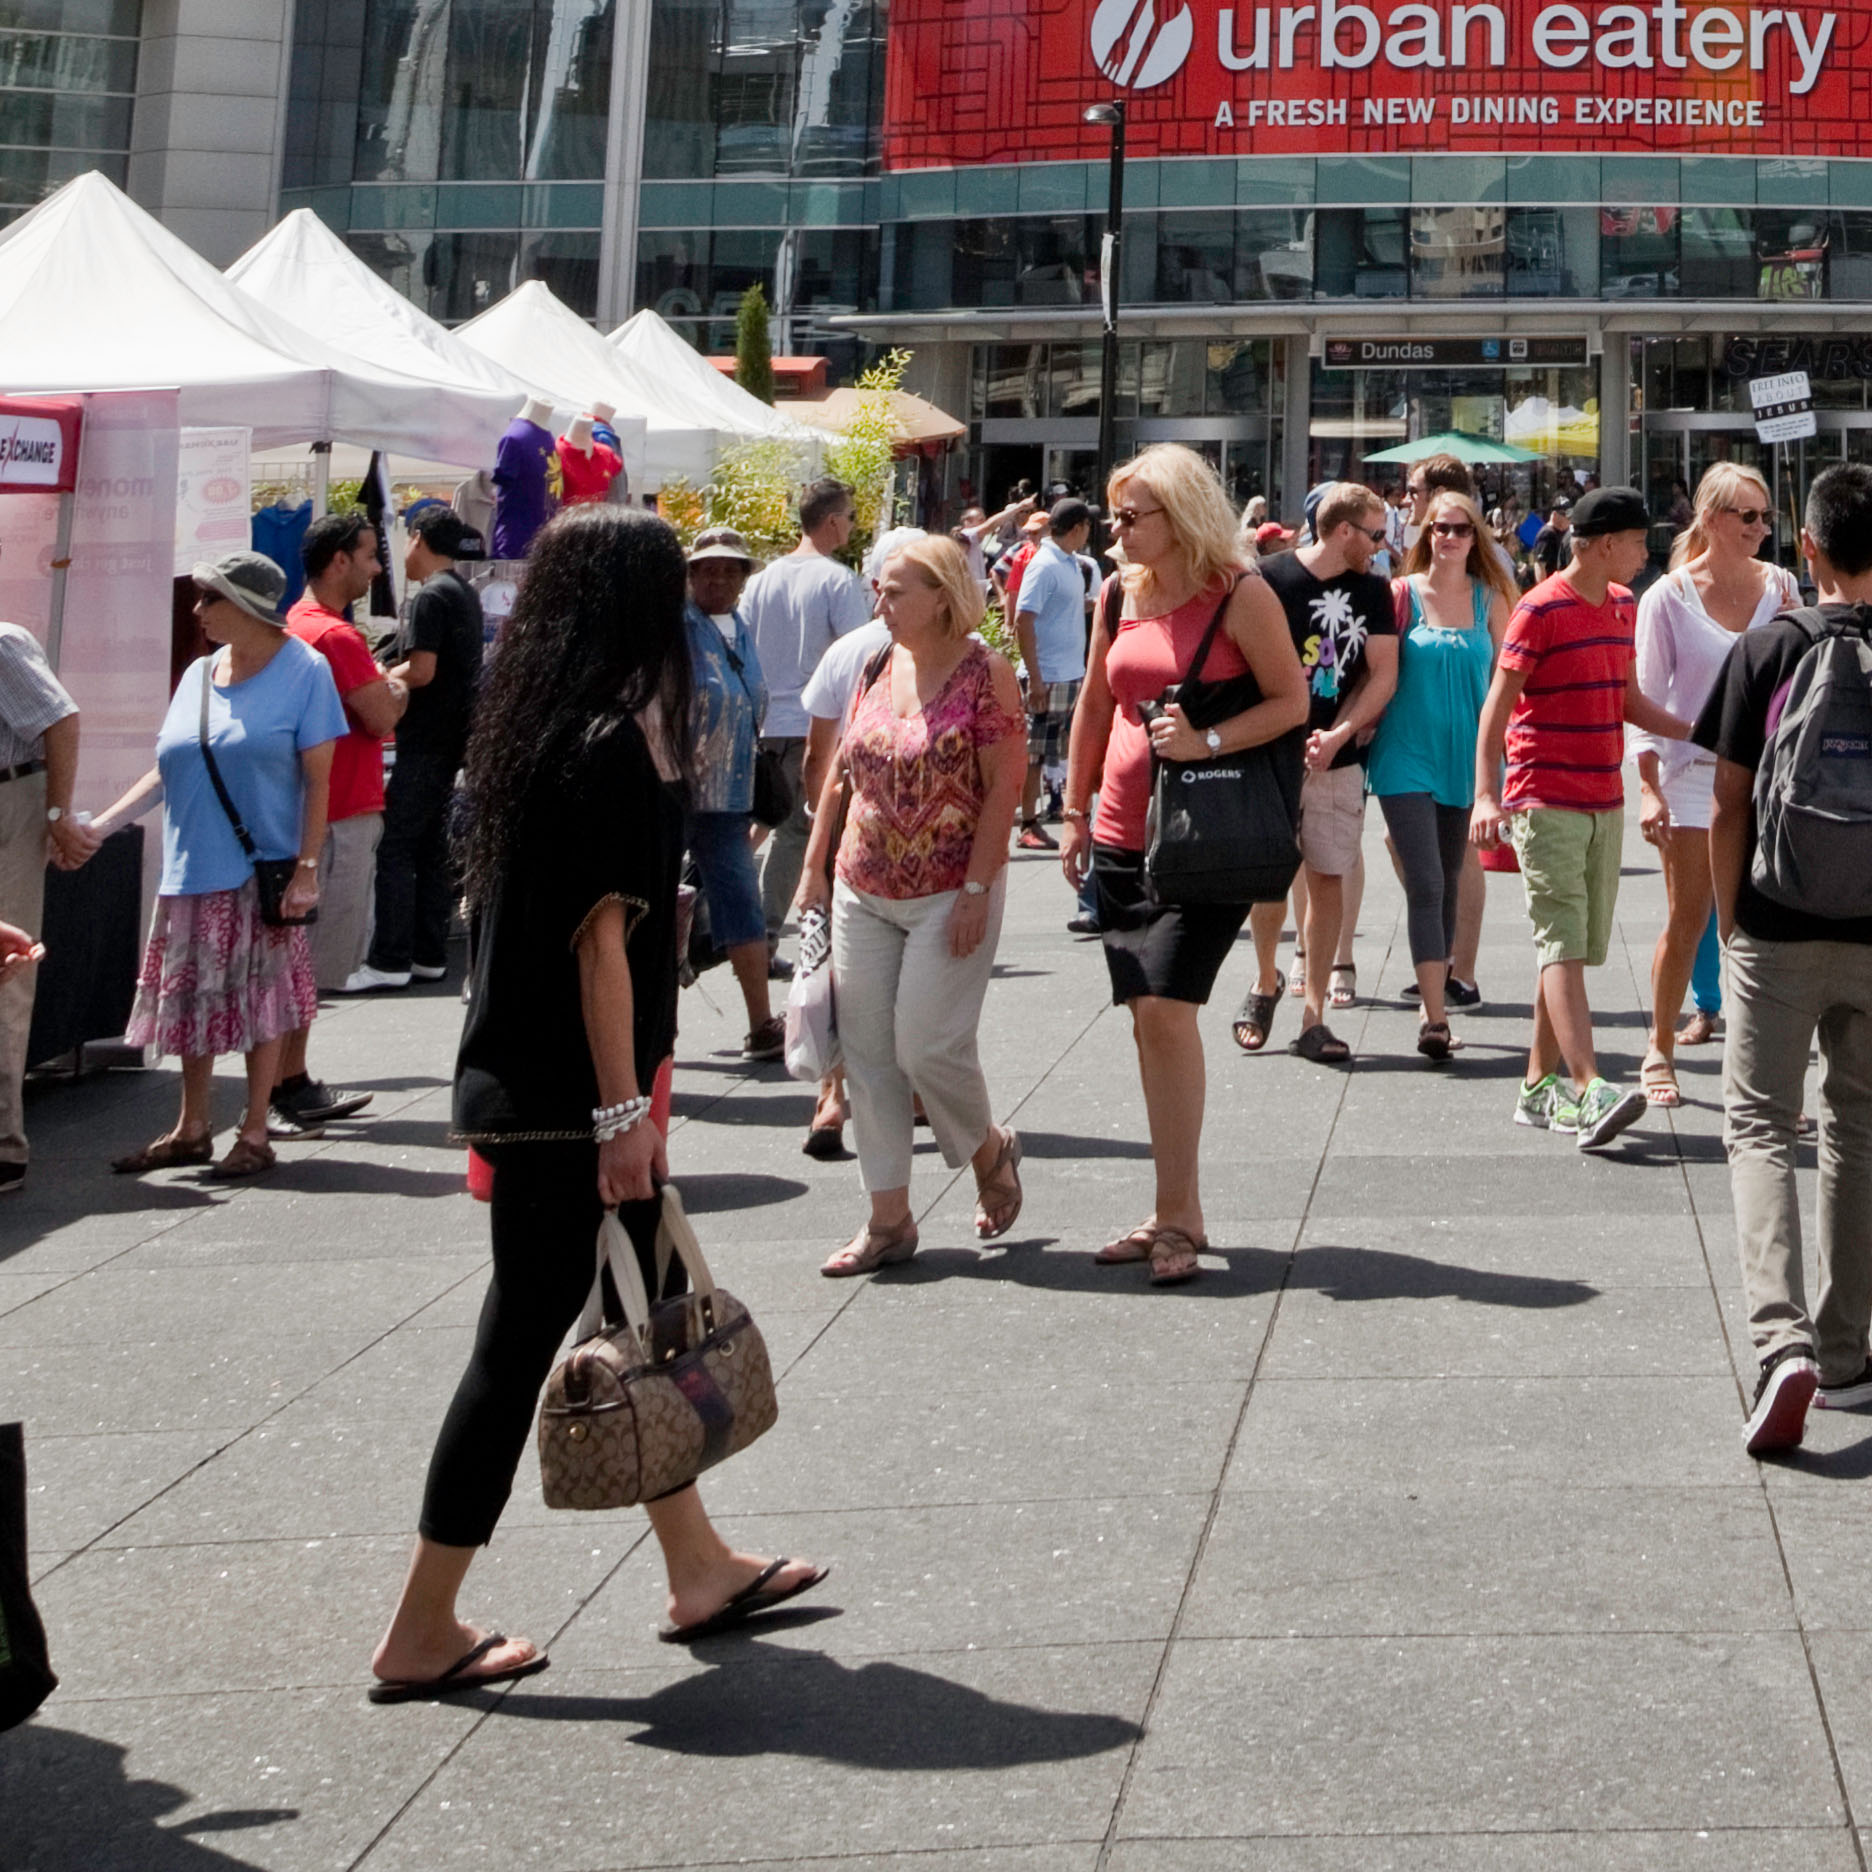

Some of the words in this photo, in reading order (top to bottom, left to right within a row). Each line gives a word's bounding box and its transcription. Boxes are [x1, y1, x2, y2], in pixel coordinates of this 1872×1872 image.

[1214, 101, 1234, 128] A
[1248, 98, 1347, 127] FRESH
[1363, 97, 1436, 125] NEW
[1452, 97, 1559, 125] DINING
[1575, 97, 1764, 127] EXPERIENCE
[1361, 342, 1434, 359] Dundas
[1752, 380, 1776, 393] FREE
[1777, 374, 1805, 388] INFO
[1756, 387, 1804, 404] ABOUT
[1757, 402, 1808, 419] JESUS
[1303, 635, 1335, 666] SO
[1198, 770, 1241, 780] ROGERS
